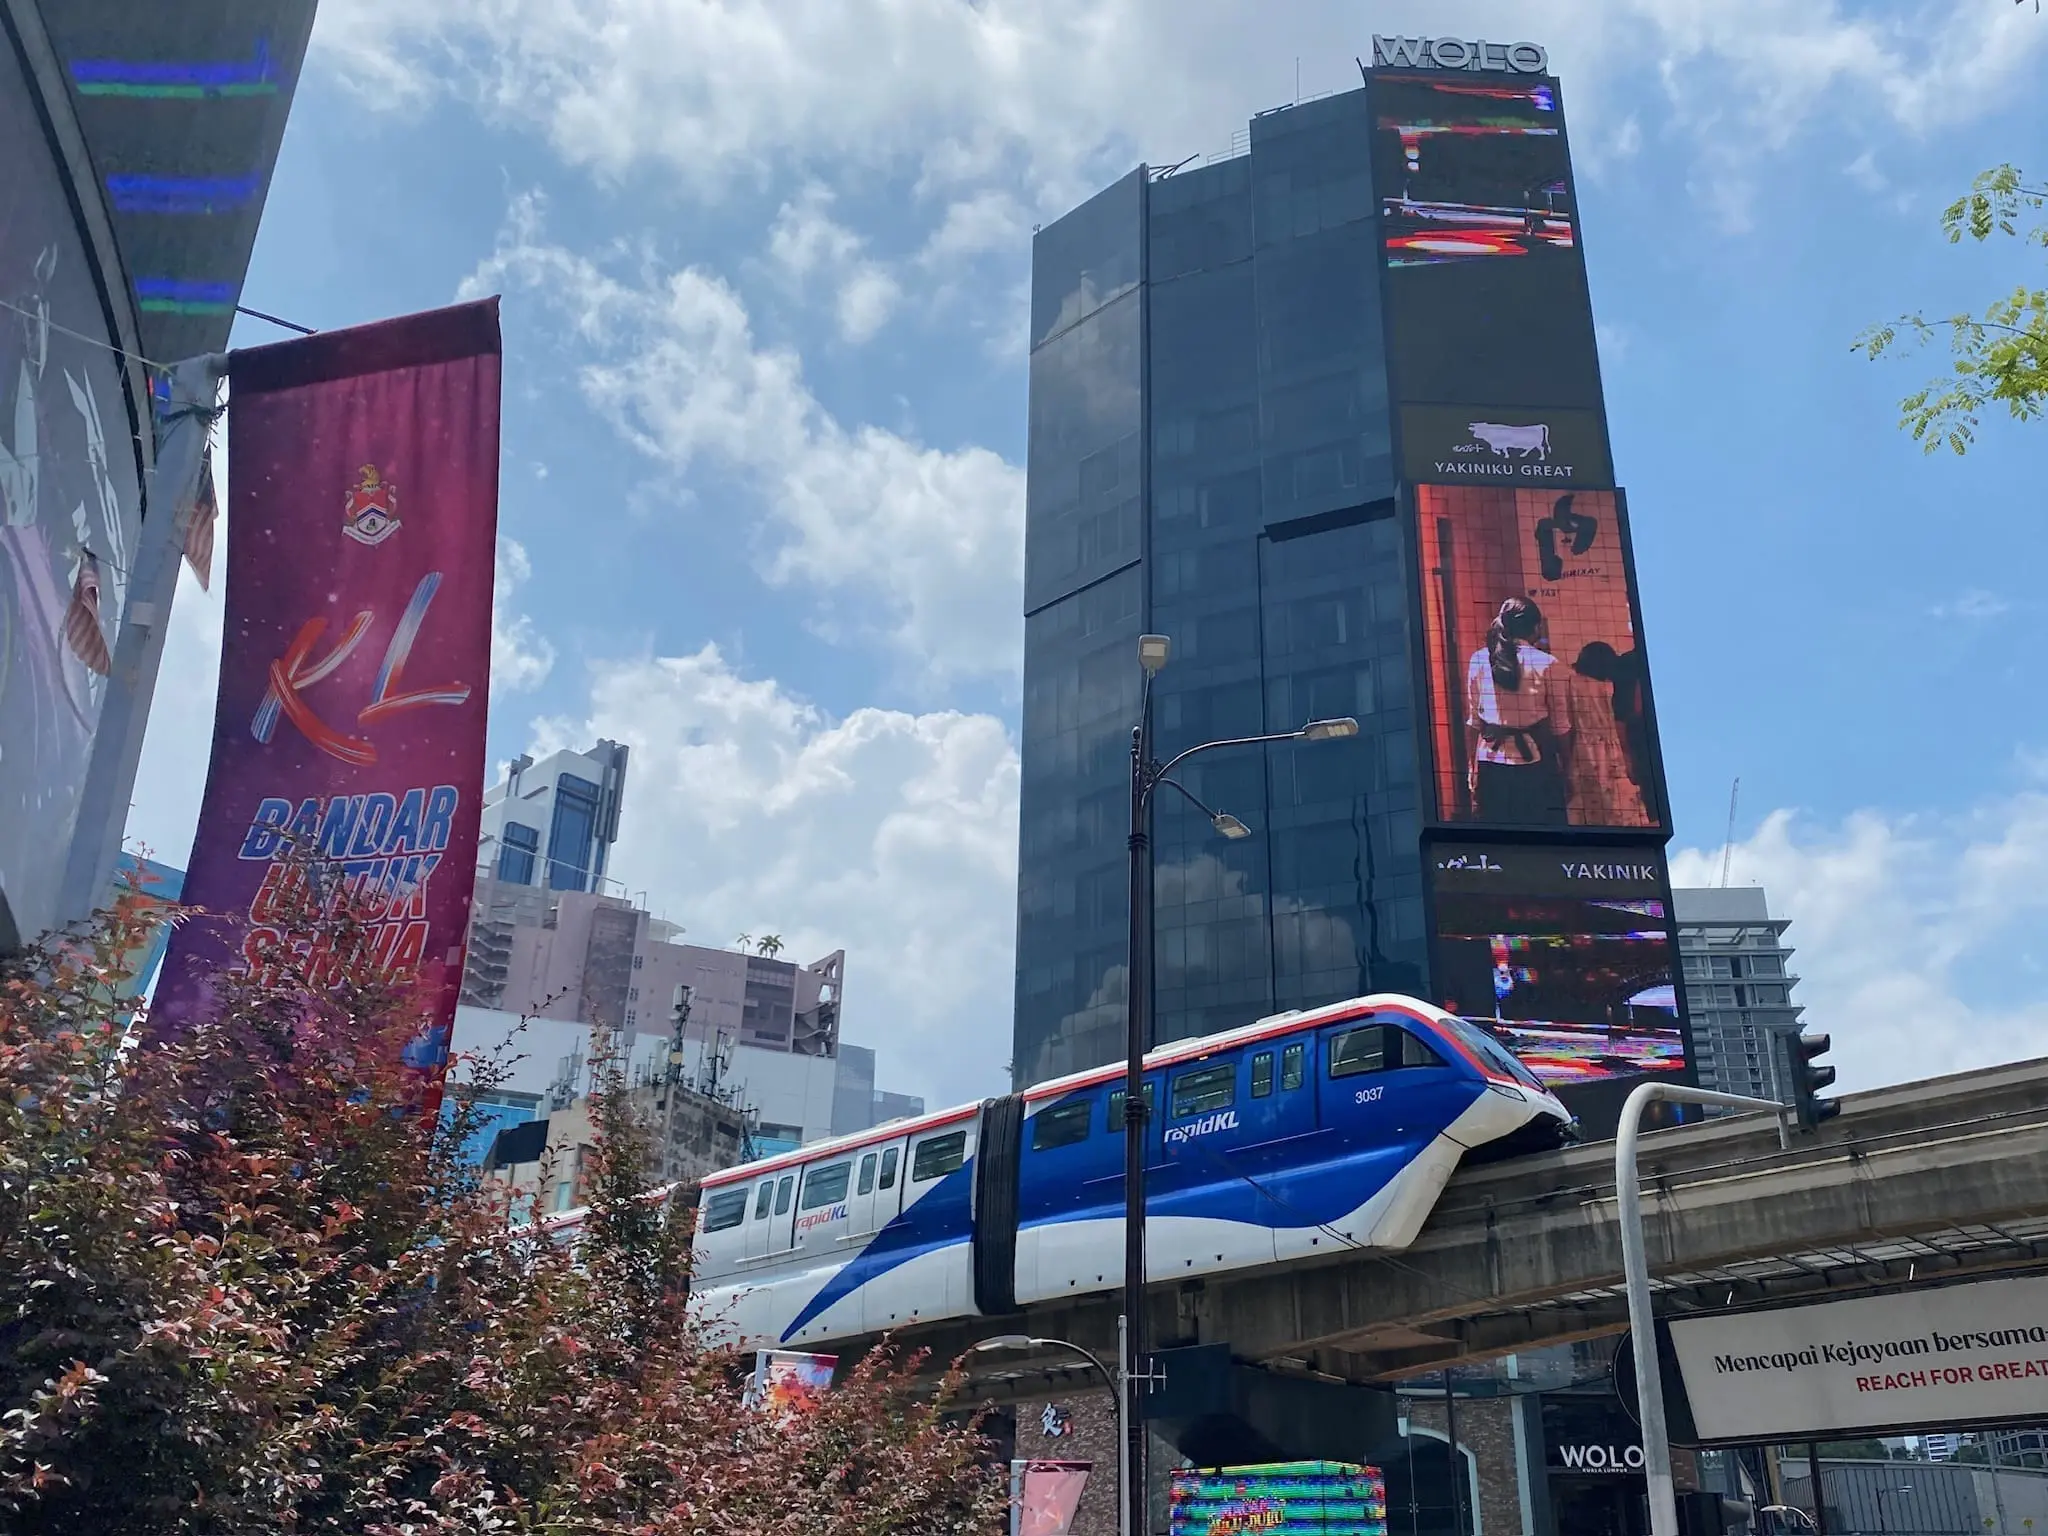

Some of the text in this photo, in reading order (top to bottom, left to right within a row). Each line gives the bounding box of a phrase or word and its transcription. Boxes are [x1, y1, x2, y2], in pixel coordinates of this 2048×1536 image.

[1372, 34, 1548, 73] WOLO
[1435, 462, 1573, 477] YAKINIKU GREAT
[250, 571, 472, 767] KL
[237, 784, 459, 860] BANDAR
[1355, 1086, 1385, 1104] 3037
[1164, 1111, 1240, 1143] rapidKL
[795, 1204, 848, 1230] rapidKL
[1714, 1345, 1819, 1373] Mencapai
[1821, 1338, 1930, 1366] Kejayaan
[1856, 1359, 2048, 1392] REACH FOR GREAT
[1559, 1445, 1645, 1468] WOLO
